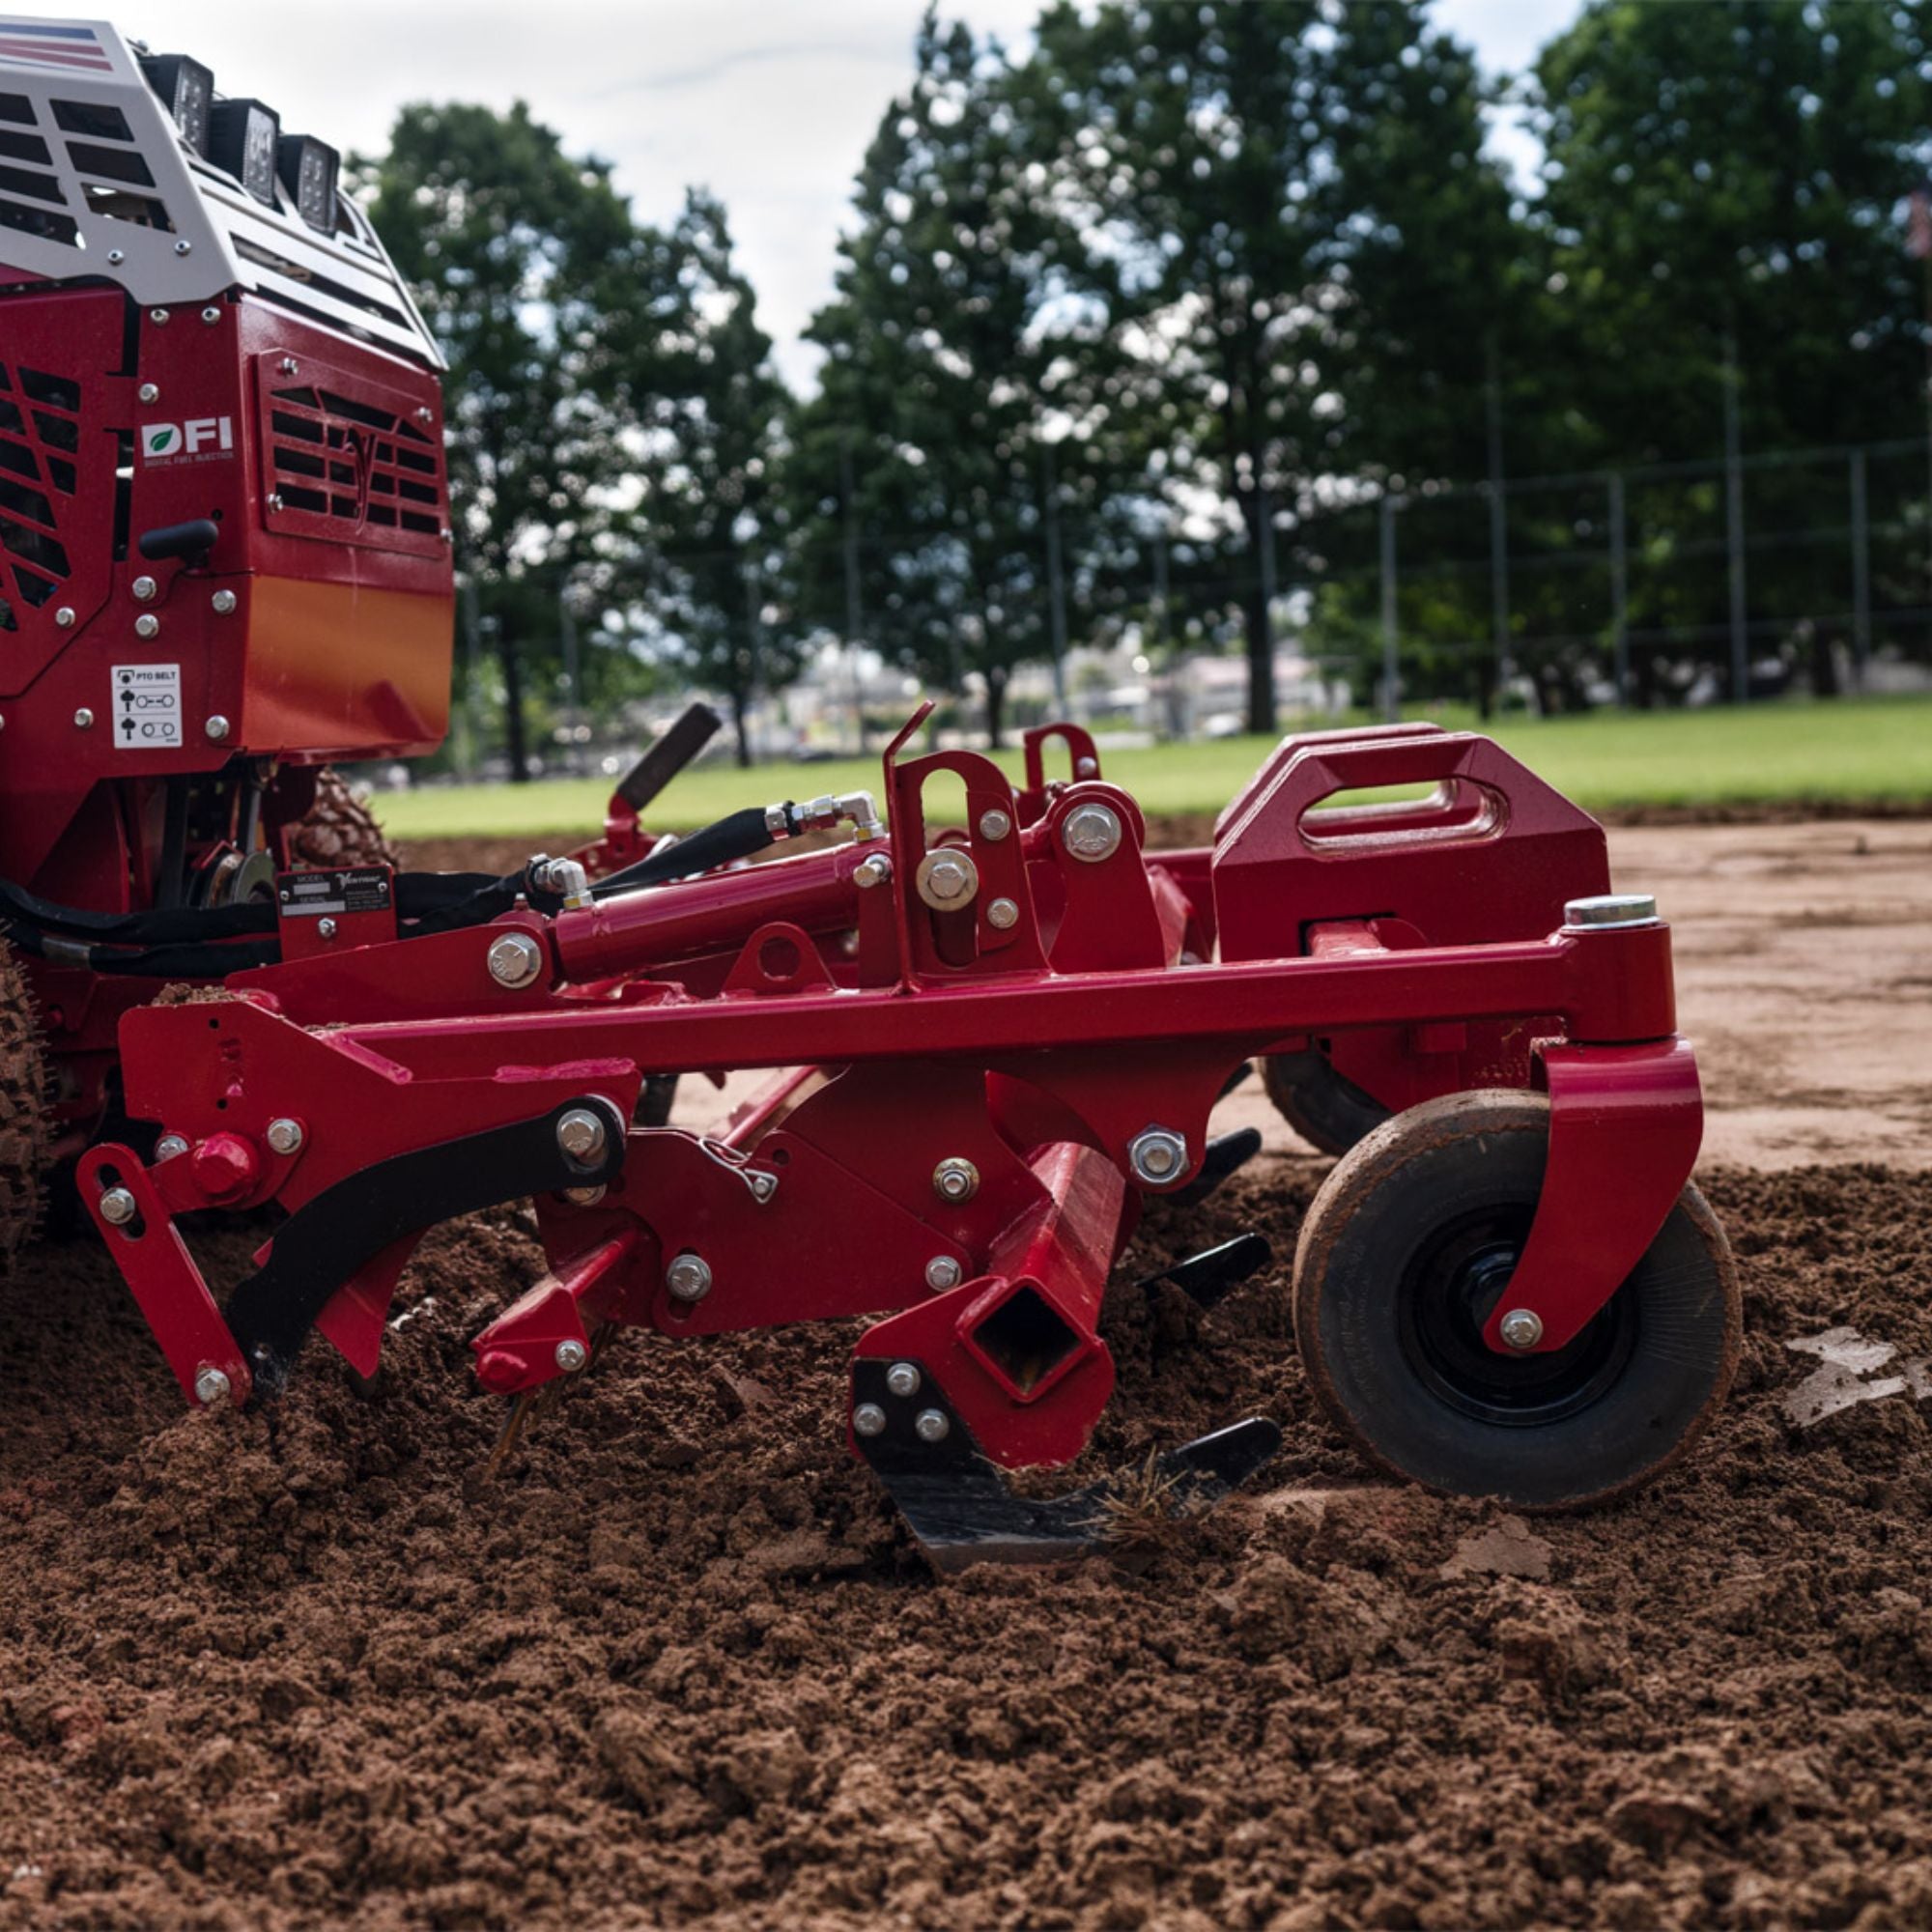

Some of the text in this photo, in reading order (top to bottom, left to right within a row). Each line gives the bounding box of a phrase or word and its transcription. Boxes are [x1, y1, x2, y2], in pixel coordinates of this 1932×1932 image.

[141, 415, 234, 458] DFI
[136, 671, 176, 680] PTO BELT
